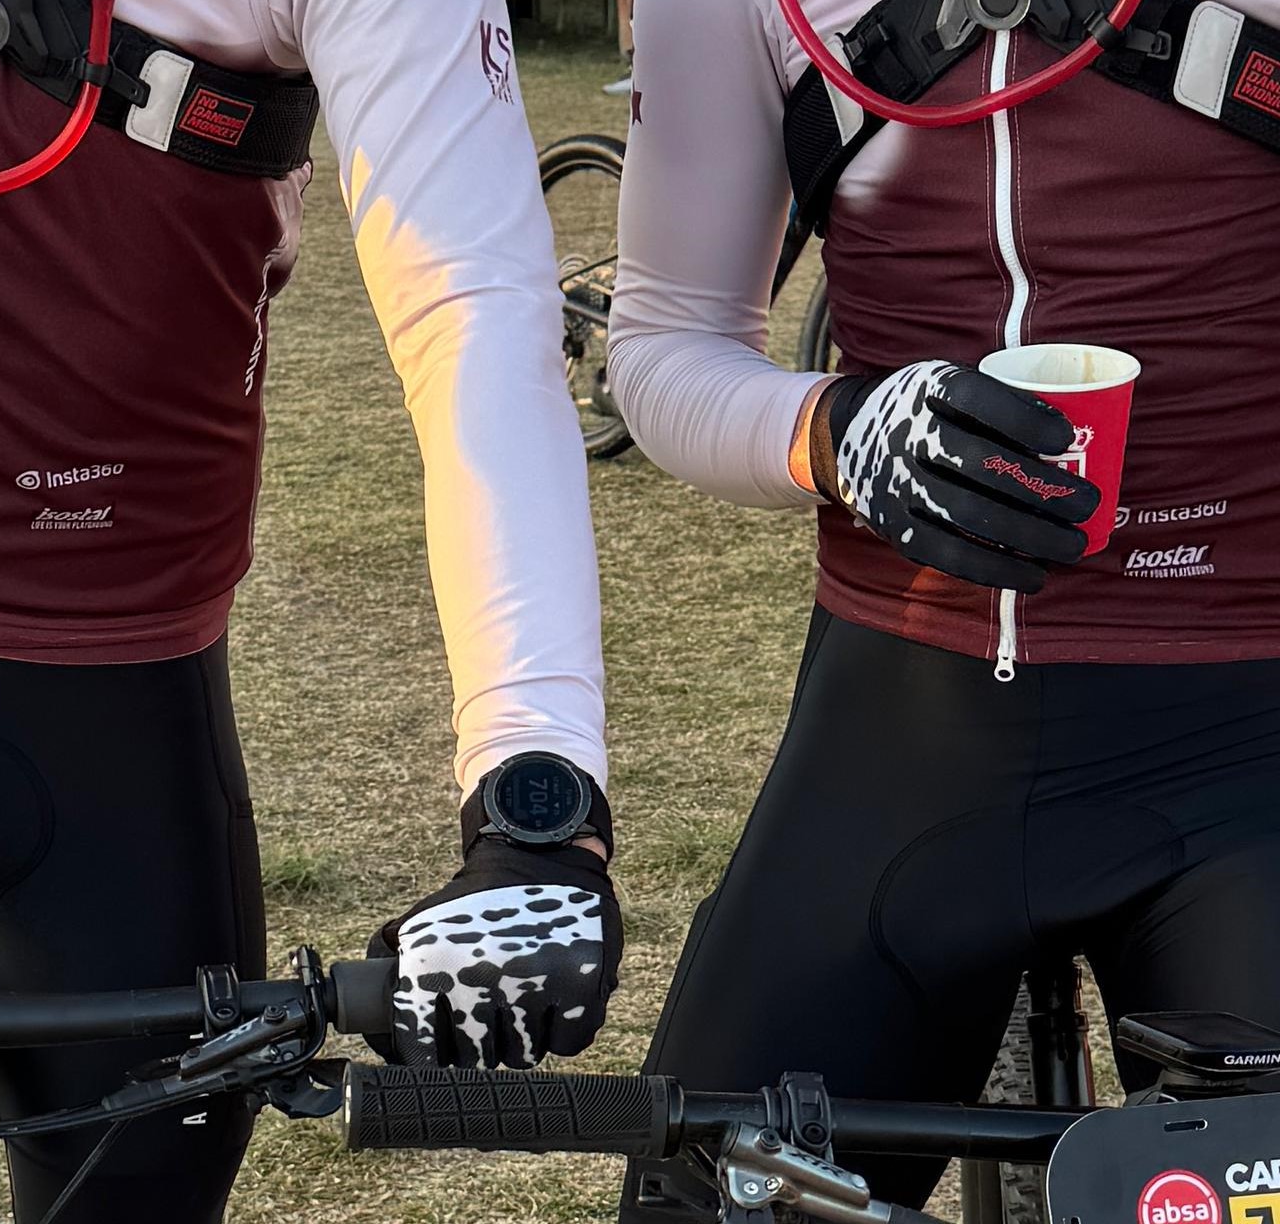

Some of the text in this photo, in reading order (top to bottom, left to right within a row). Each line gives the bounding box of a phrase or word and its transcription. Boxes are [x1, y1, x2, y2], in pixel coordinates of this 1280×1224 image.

[1252, 59, 1275, 76] NO
[198, 95, 219, 109] NO
[46, 463, 125, 489] Insta360
[1126, 544, 1210, 569] isostar
[1152, 1198, 1210, 1224] absa
